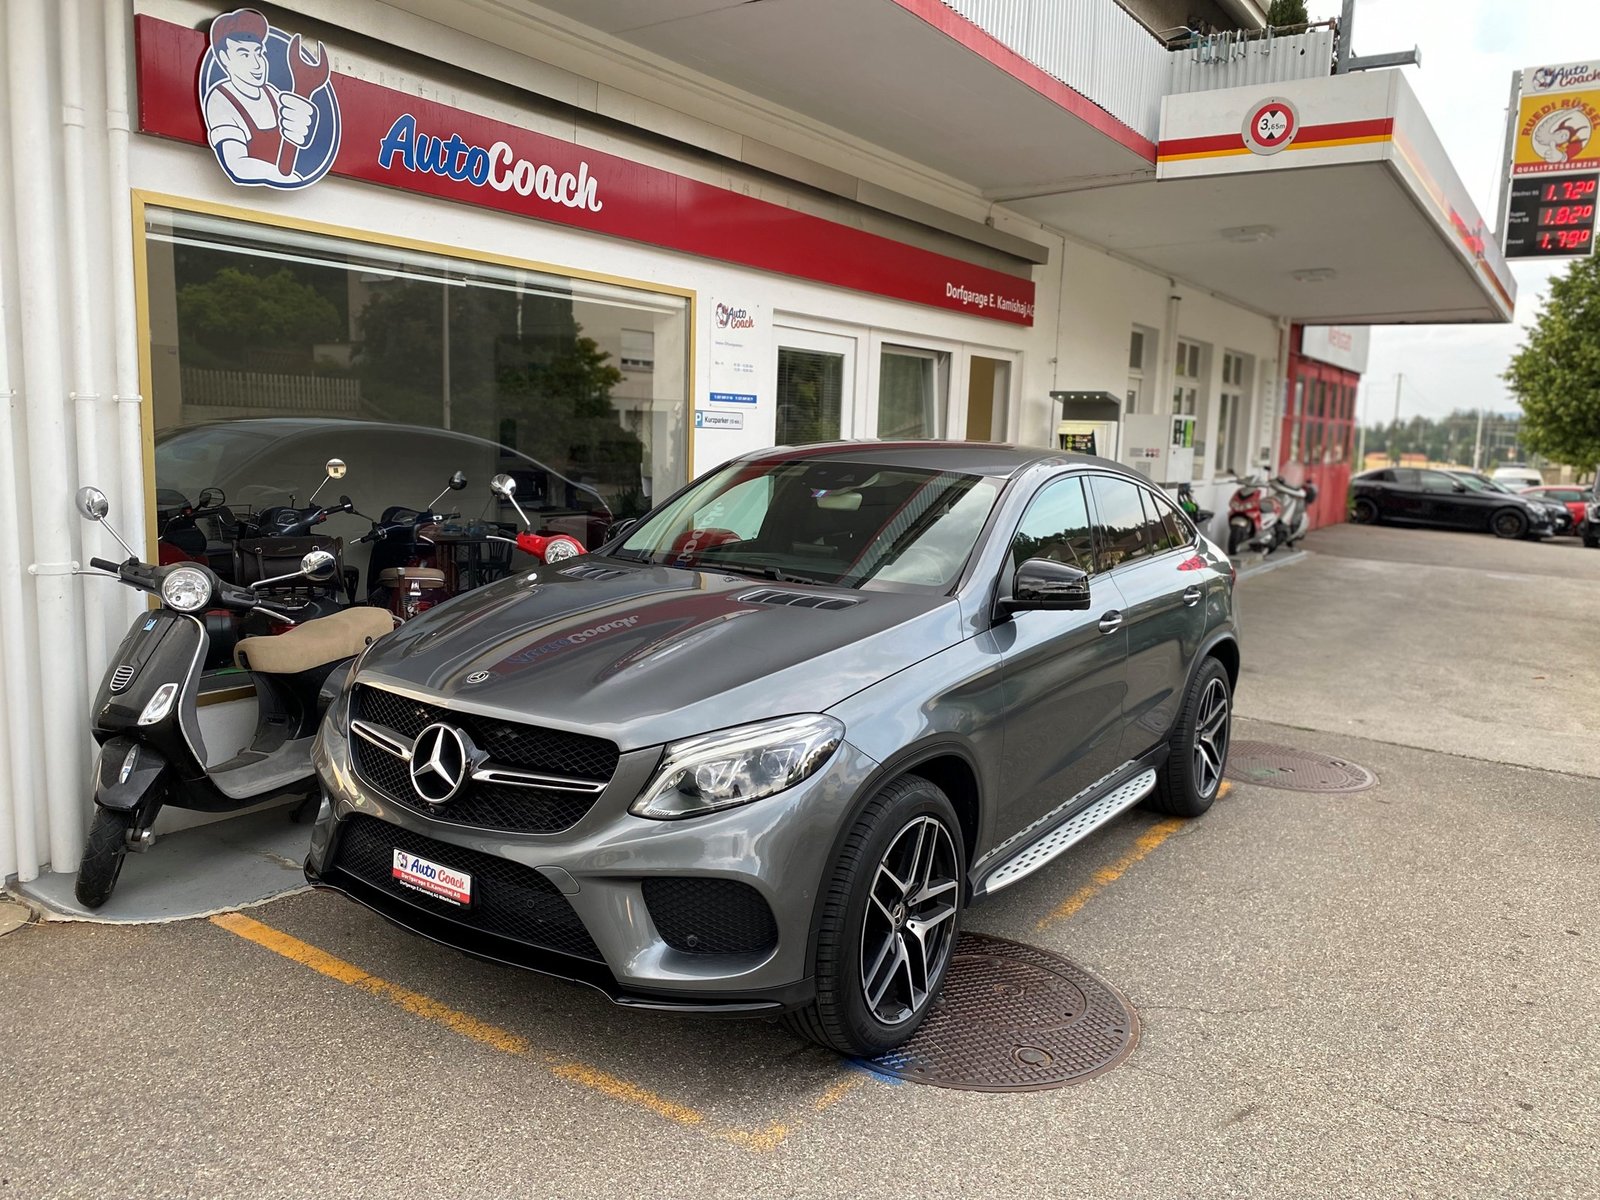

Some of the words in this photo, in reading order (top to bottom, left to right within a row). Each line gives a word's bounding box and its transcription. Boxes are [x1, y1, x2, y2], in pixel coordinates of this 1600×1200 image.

[1522, 102, 1556, 137] RUEDI
[946, 282, 988, 308] Dorfgarage
[989, 293, 996, 307] E.
[997, 295, 1027, 318] Kamishaj
[728, 307, 746, 319] Auto
[731, 315, 754, 329] Coach
[704, 416, 729, 424] Kurzparker
[411, 858, 436, 879] Auto
[437, 869, 465, 890] Coach
